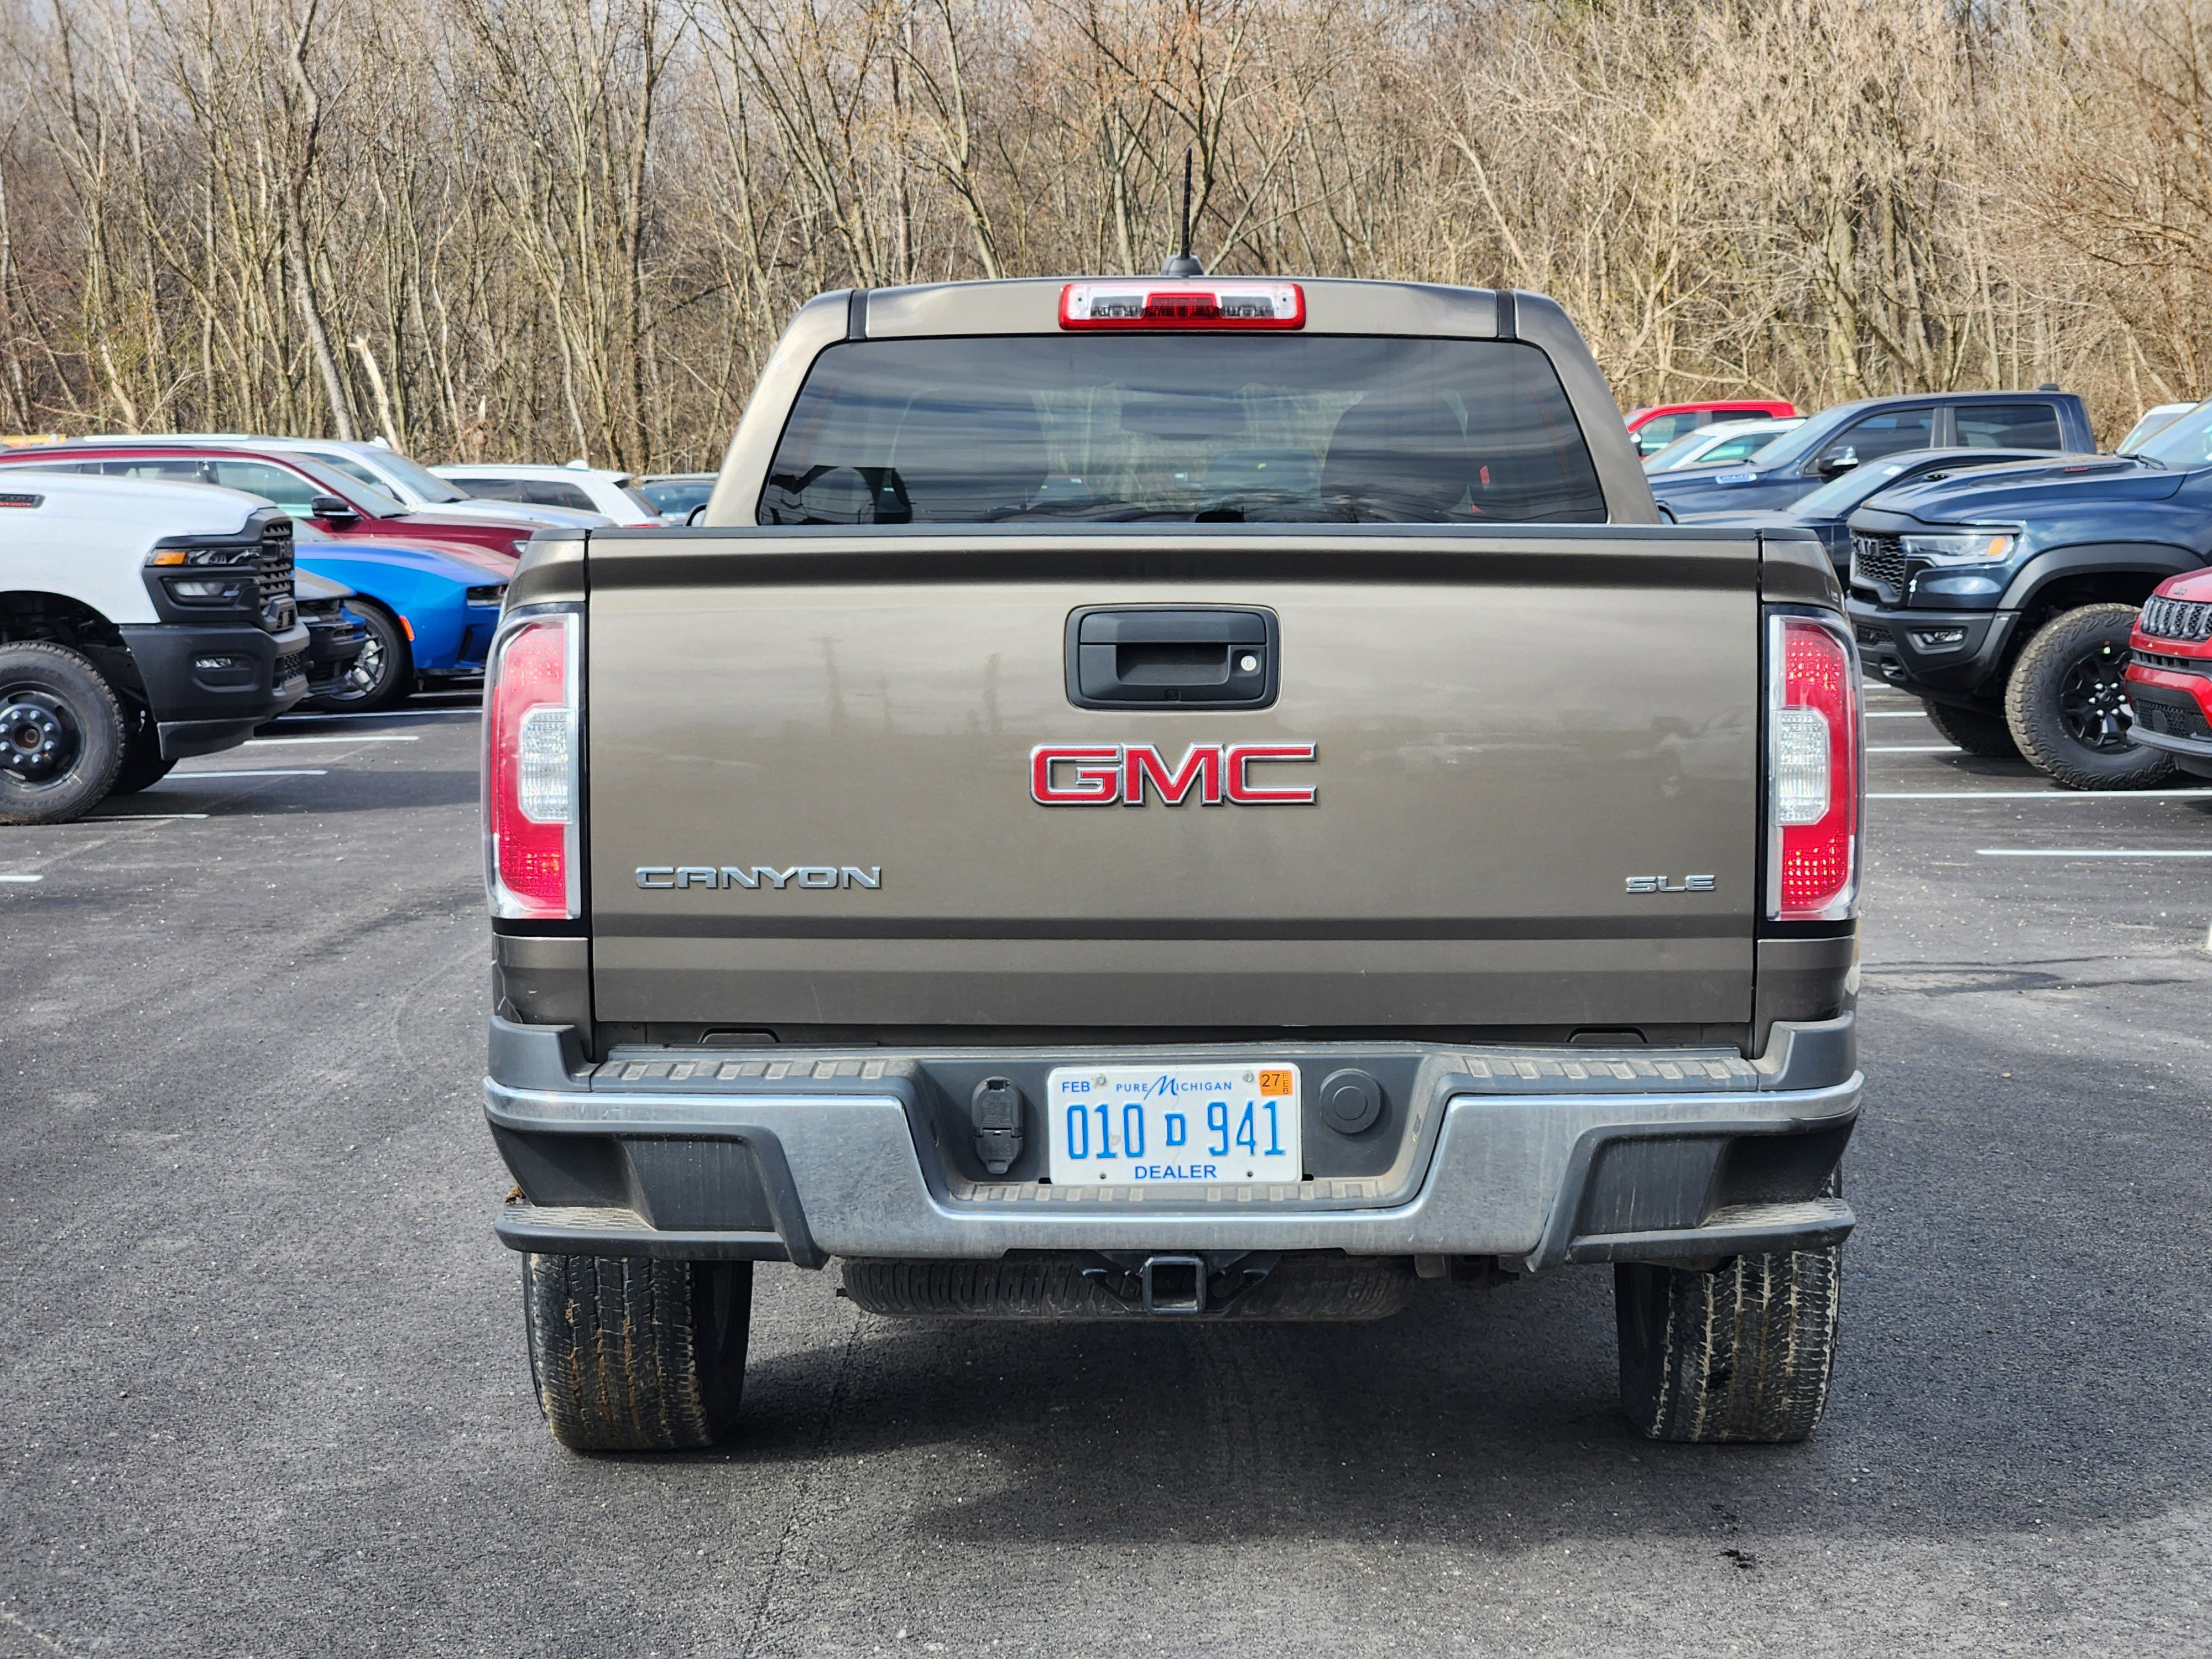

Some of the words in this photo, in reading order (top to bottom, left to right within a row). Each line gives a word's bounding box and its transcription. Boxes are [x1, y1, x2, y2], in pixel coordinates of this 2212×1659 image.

[1030, 742, 1317, 806] GMC
[635, 866, 881, 889] CANYON
[1625, 875, 1715, 893] SLE
[1062, 1081, 1091, 1093] FEB
[1116, 1083, 1148, 1092] PURE
[1144, 1074, 1232, 1100] MICHIGAN
[1261, 1073, 1280, 1088] 27
[1067, 1103, 1145, 1159] 010
[1164, 1112, 1186, 1146] D
[1207, 1100, 1286, 1156] 941
[1134, 1165, 1217, 1180] DEALER
